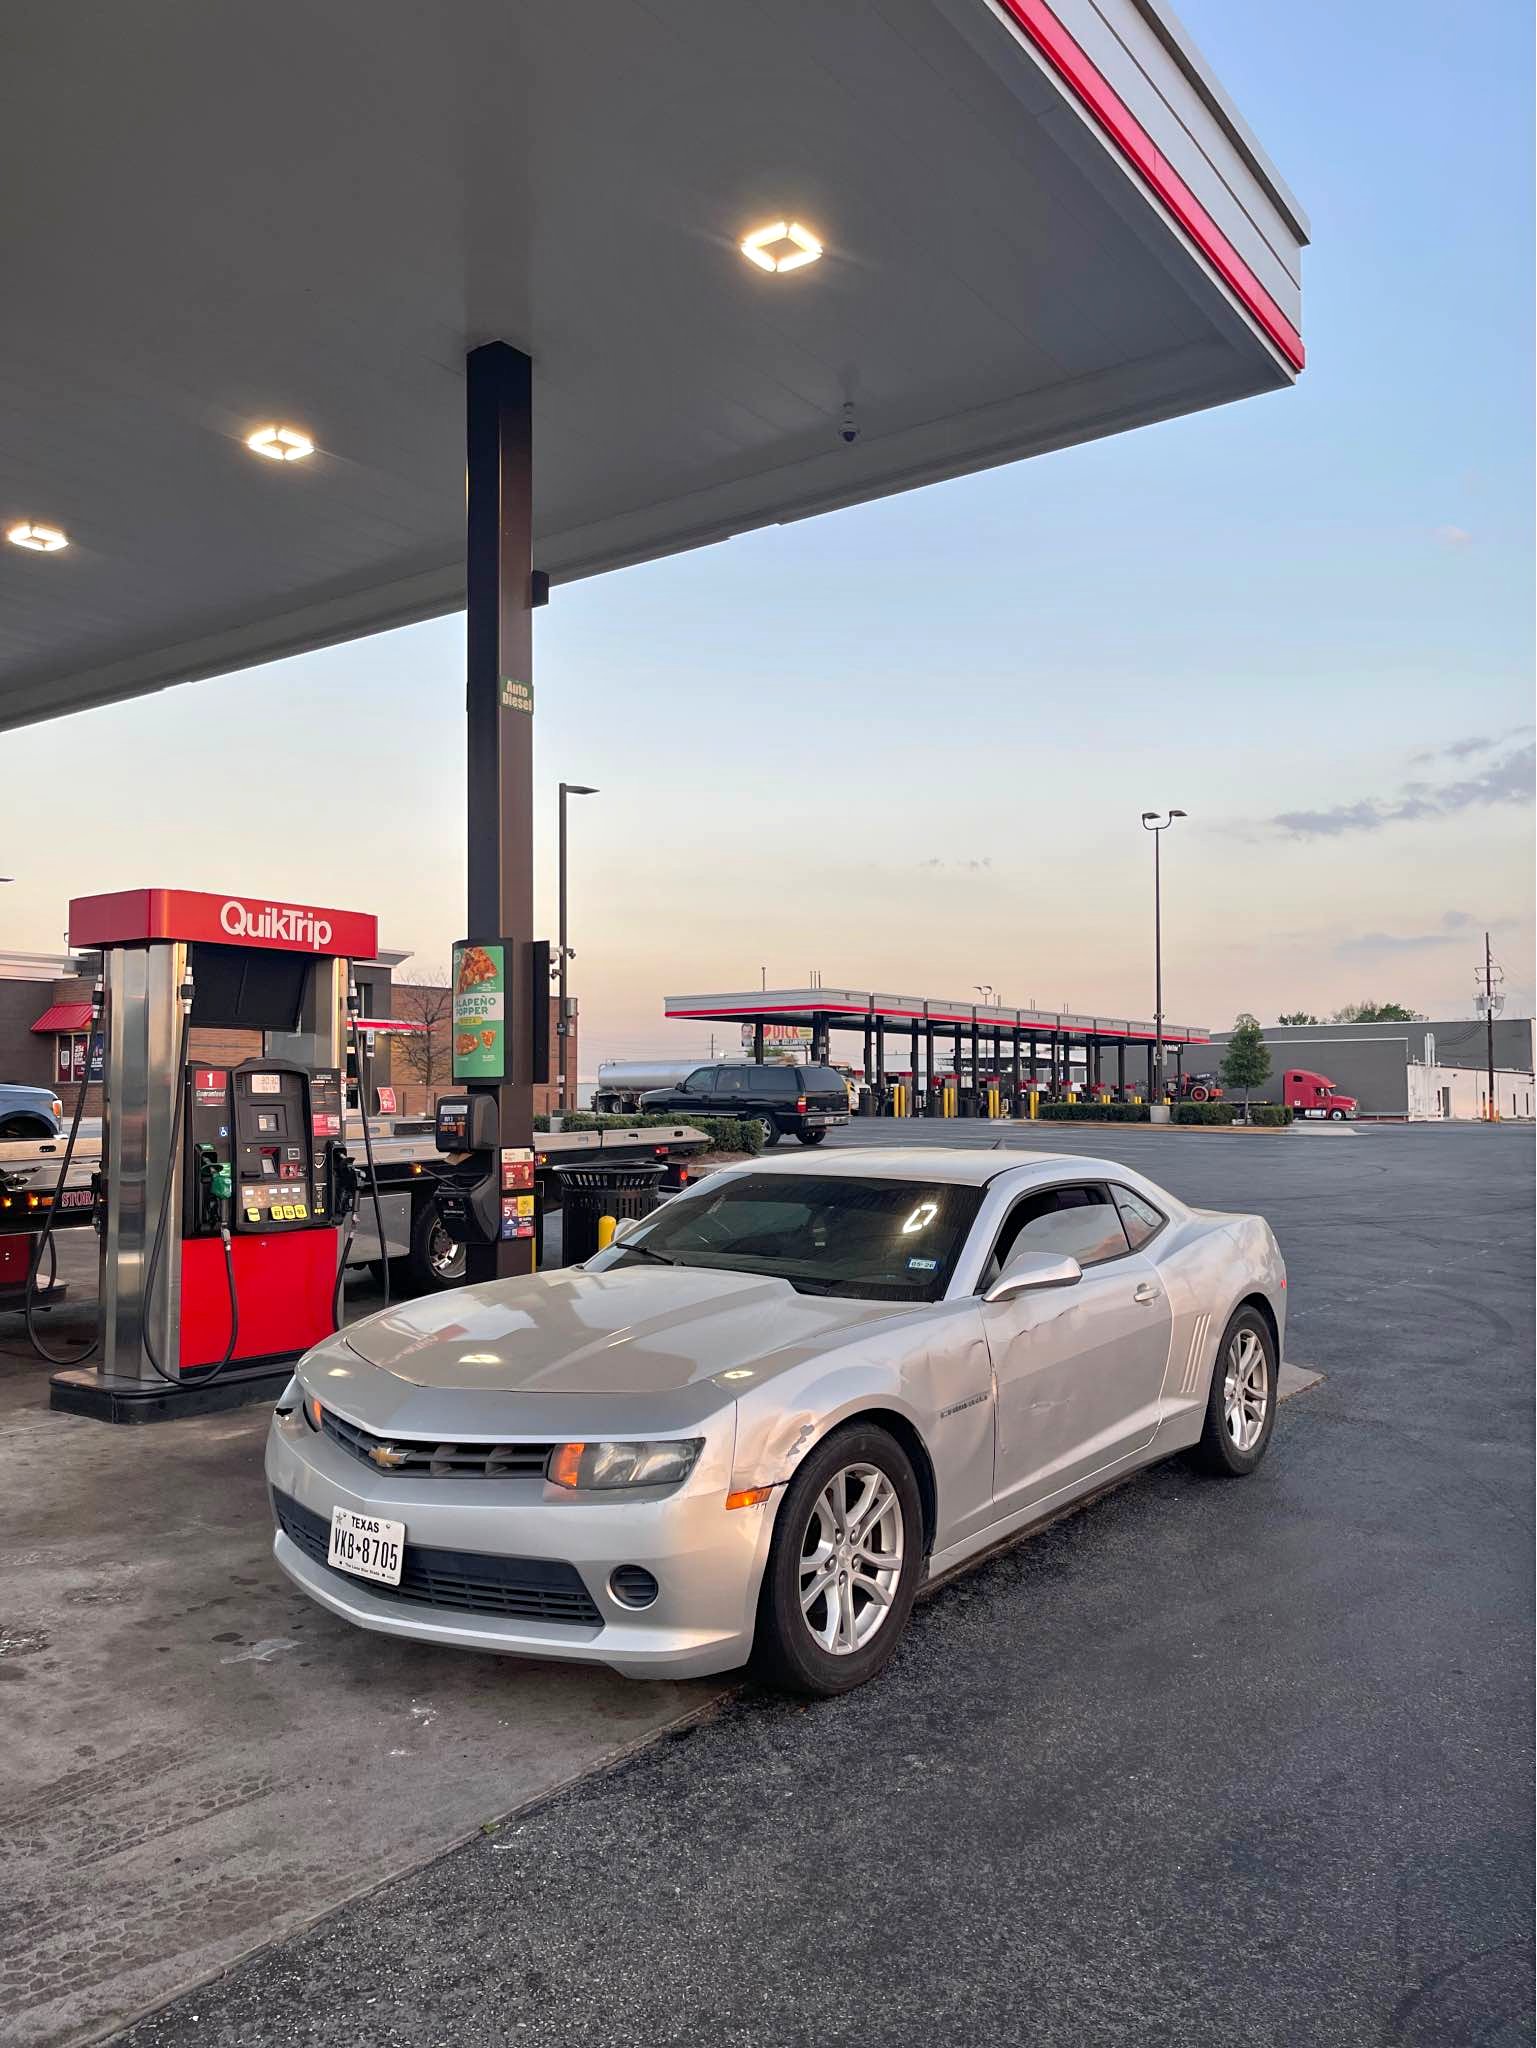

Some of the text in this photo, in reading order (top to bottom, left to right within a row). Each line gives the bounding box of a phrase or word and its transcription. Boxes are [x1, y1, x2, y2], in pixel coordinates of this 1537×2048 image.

[506, 680, 528, 698] Auto
[502, 691, 532, 712] Diesel
[220, 900, 332, 951] QuikTrip
[207, 1072, 214, 1088] 1
[351, 1516, 380, 1533] TEXAS
[334, 1527, 399, 1571] VKB 8705
